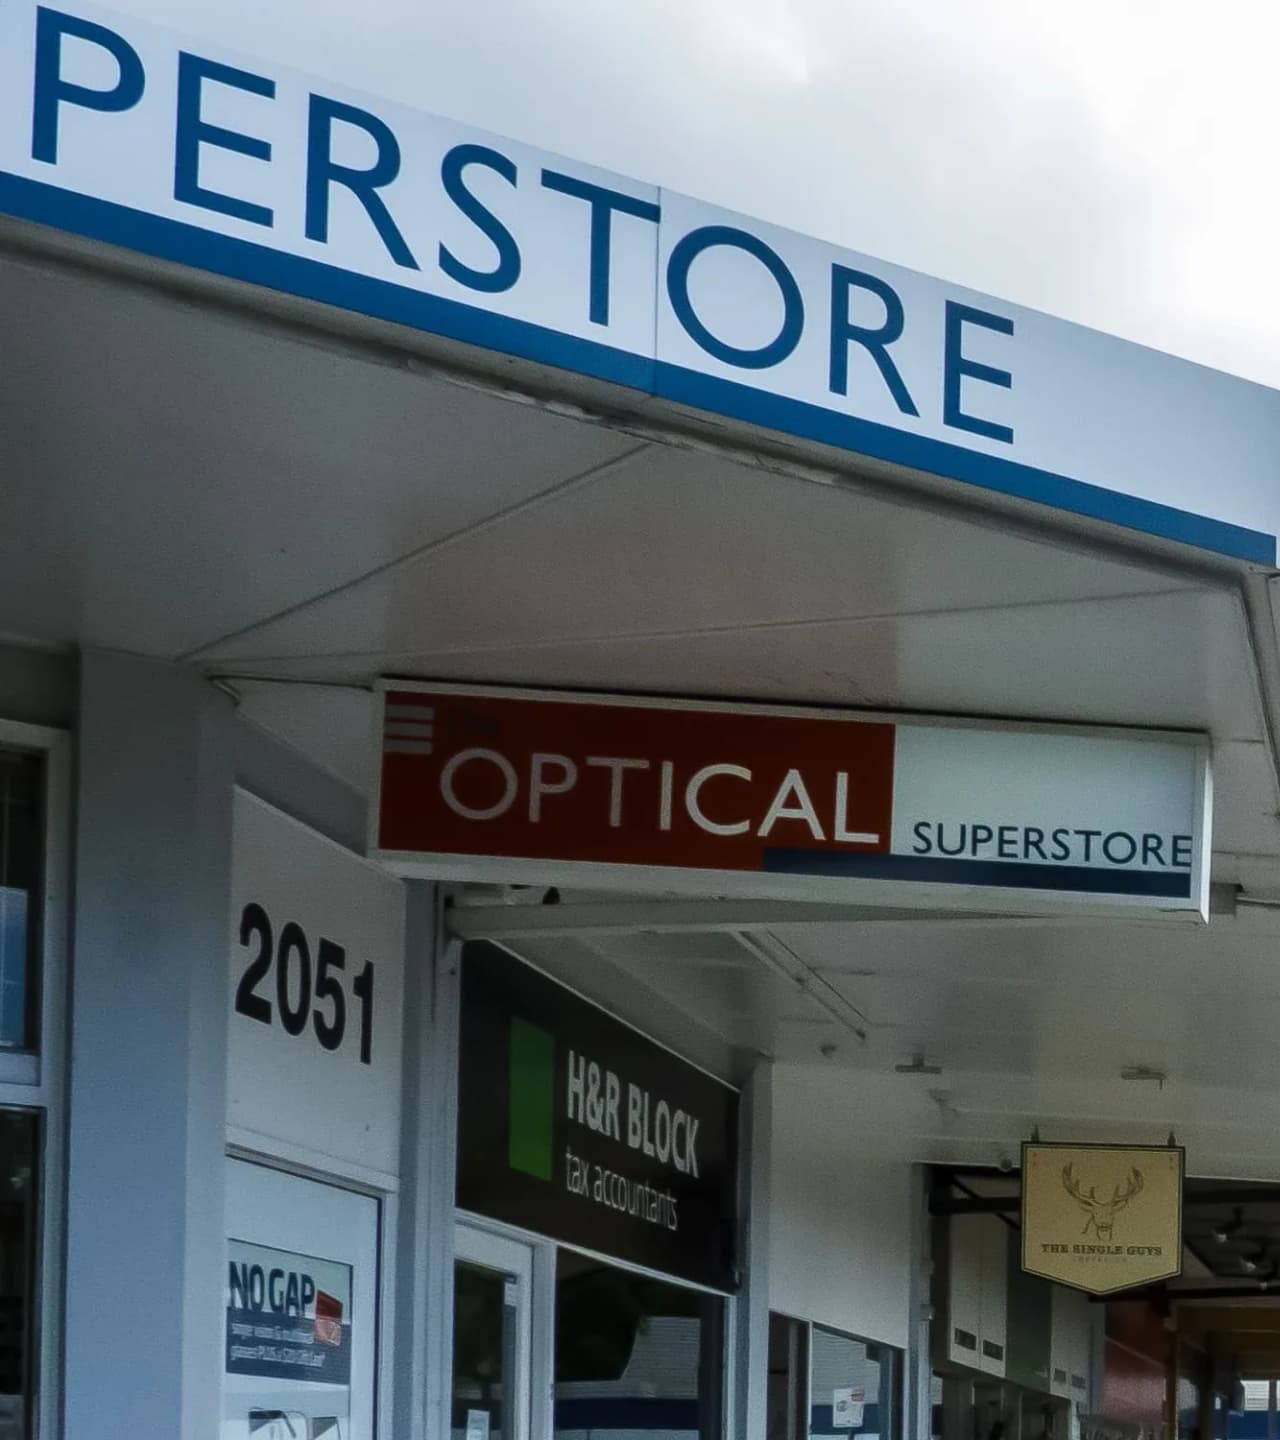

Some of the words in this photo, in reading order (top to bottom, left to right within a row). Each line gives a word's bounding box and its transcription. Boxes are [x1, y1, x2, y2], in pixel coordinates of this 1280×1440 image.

[31, 5, 1014, 446] PERSTORE
[439, 747, 880, 845] OPTICAL
[912, 820, 1193, 869] SUPERSTORE
[235, 902, 374, 1066] 2051
[567, 1050, 621, 1140] H&R
[627, 1083, 700, 1179] BLOCK
[566, 1145, 590, 1198] tax
[593, 1165, 679, 1231] accountants
[229, 1260, 265, 1312] NO
[268, 1267, 316, 1318] GAP
[1041, 1243, 1069, 1254] THE
[1126, 1245, 1163, 1256] GUYS
